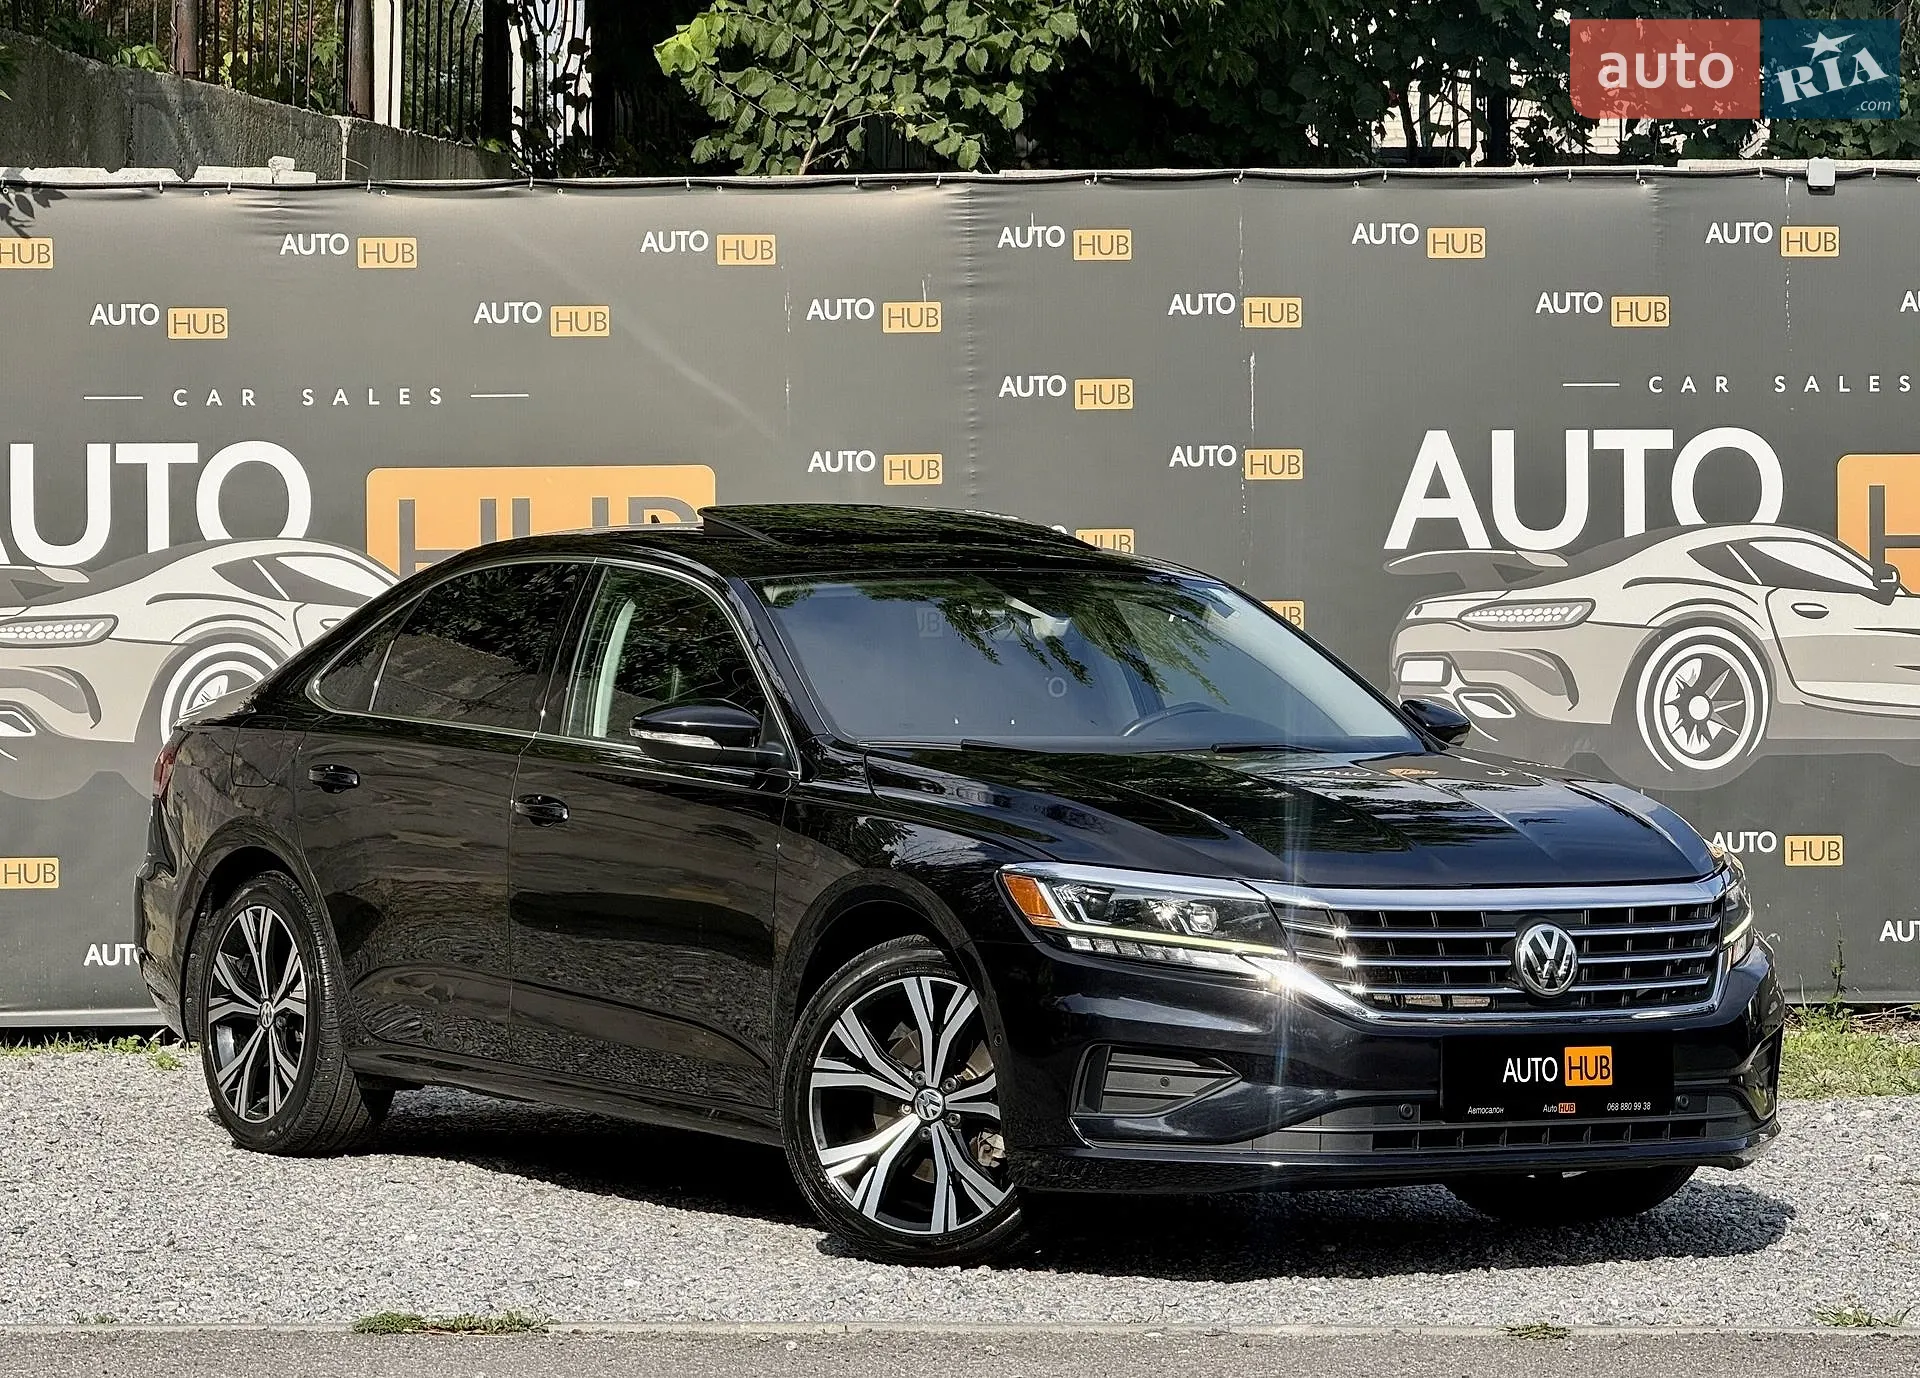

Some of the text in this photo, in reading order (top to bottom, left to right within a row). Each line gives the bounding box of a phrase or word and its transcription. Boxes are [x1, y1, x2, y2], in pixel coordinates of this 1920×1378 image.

[280, 233, 415, 264] AUTO HUB
[640, 230, 774, 261] AUTO HUB
[998, 226, 1130, 256] AUTO HUB
[1352, 223, 1484, 254] AUTO HUB
[1706, 222, 1837, 253] AUTO HUB
[0, 243, 51, 264] HUB
[90, 304, 226, 335] AUTO HUB
[474, 302, 607, 333] AUTO HUB
[807, 298, 939, 329] AUTO HUB
[1168, 293, 1300, 324] AUTO HUB
[1536, 292, 1667, 323] AUTO HUB
[173, 387, 443, 407] CAR SALES
[999, 375, 1131, 405] AUTO HUB
[1648, 375, 1912, 393] CAR SALES
[808, 450, 940, 480] AUTO HUB
[1169, 445, 1301, 476] AUTO HUB
[0, 440, 312, 567] UTO
[1383, 427, 1784, 550] AUTO
[1712, 831, 1841, 862] AUTO HUB
[4, 863, 56, 884] HUB
[1502, 1055, 1611, 1083] AUTO HUB
[1543, 1103, 1575, 1113] Auto HUB
[1606, 1102, 1619, 1111] 068
[1633, 1101, 1642, 1111] 99
